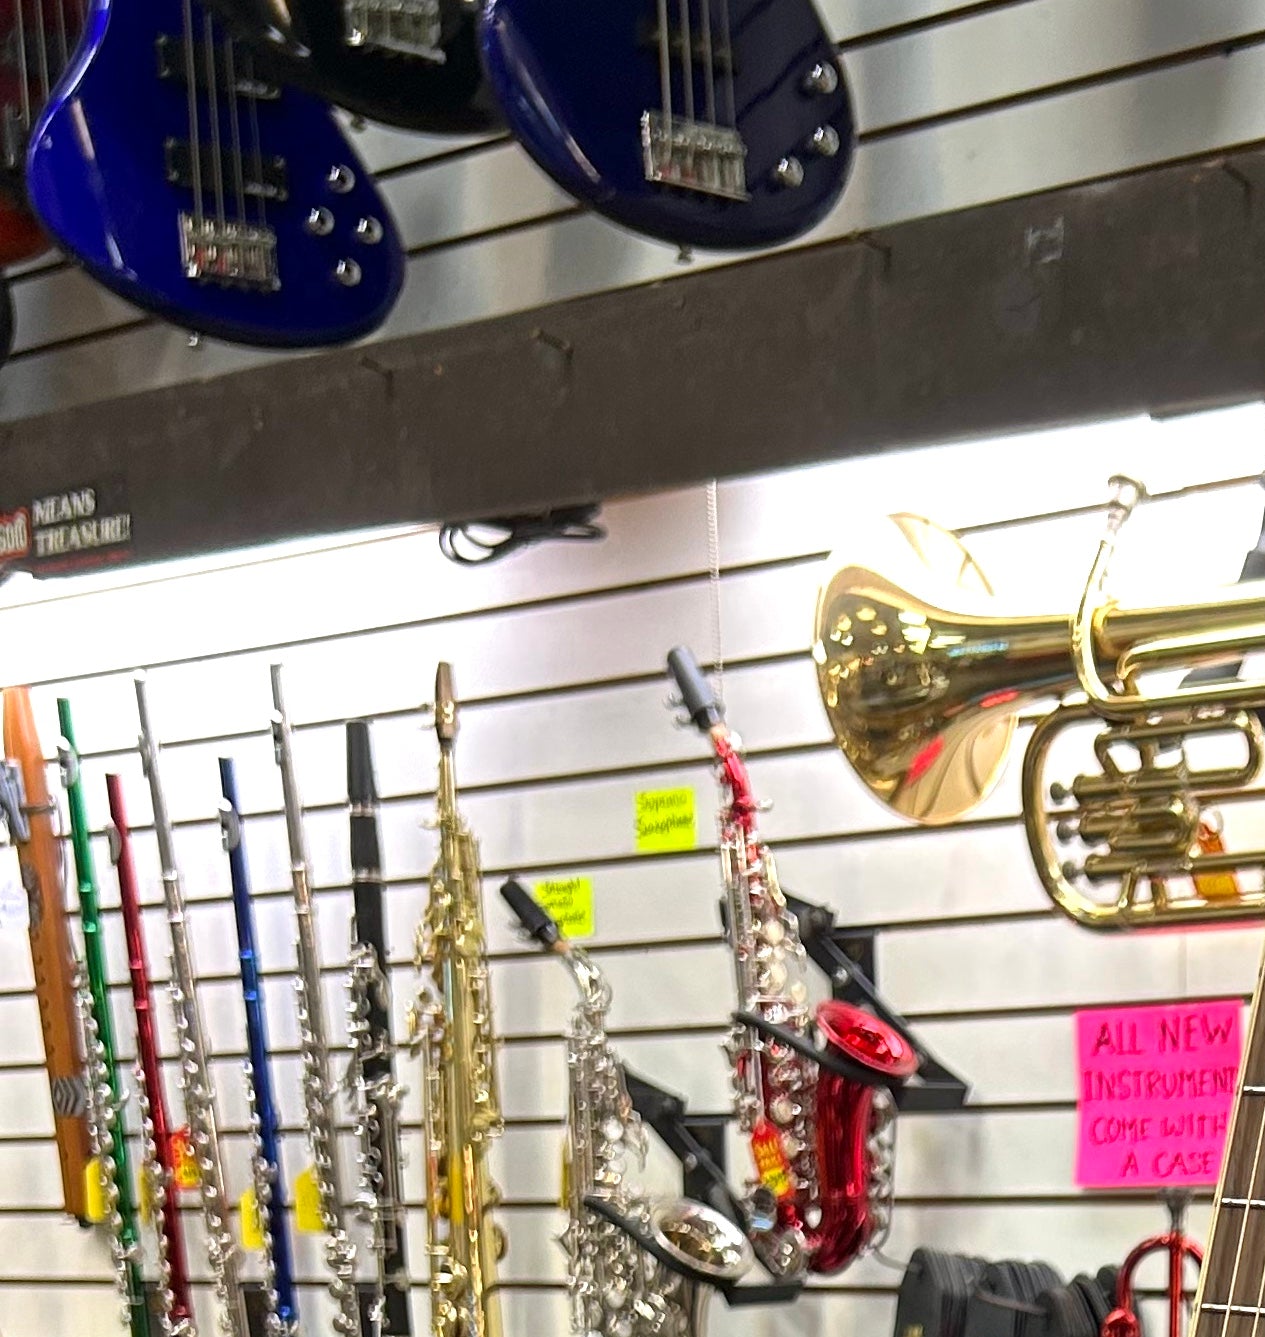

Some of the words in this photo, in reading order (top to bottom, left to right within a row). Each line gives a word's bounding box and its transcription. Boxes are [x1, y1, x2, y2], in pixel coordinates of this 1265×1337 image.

[32, 487, 96, 526] MEANS
[1091, 1022, 1142, 1056] ALL
[1158, 1014, 1233, 1053] NEW
[1089, 1116, 1151, 1145] COME
[1160, 1111, 1228, 1140] WITH
[1120, 1151, 1139, 1177] A
[1152, 1151, 1215, 1178] CASE
